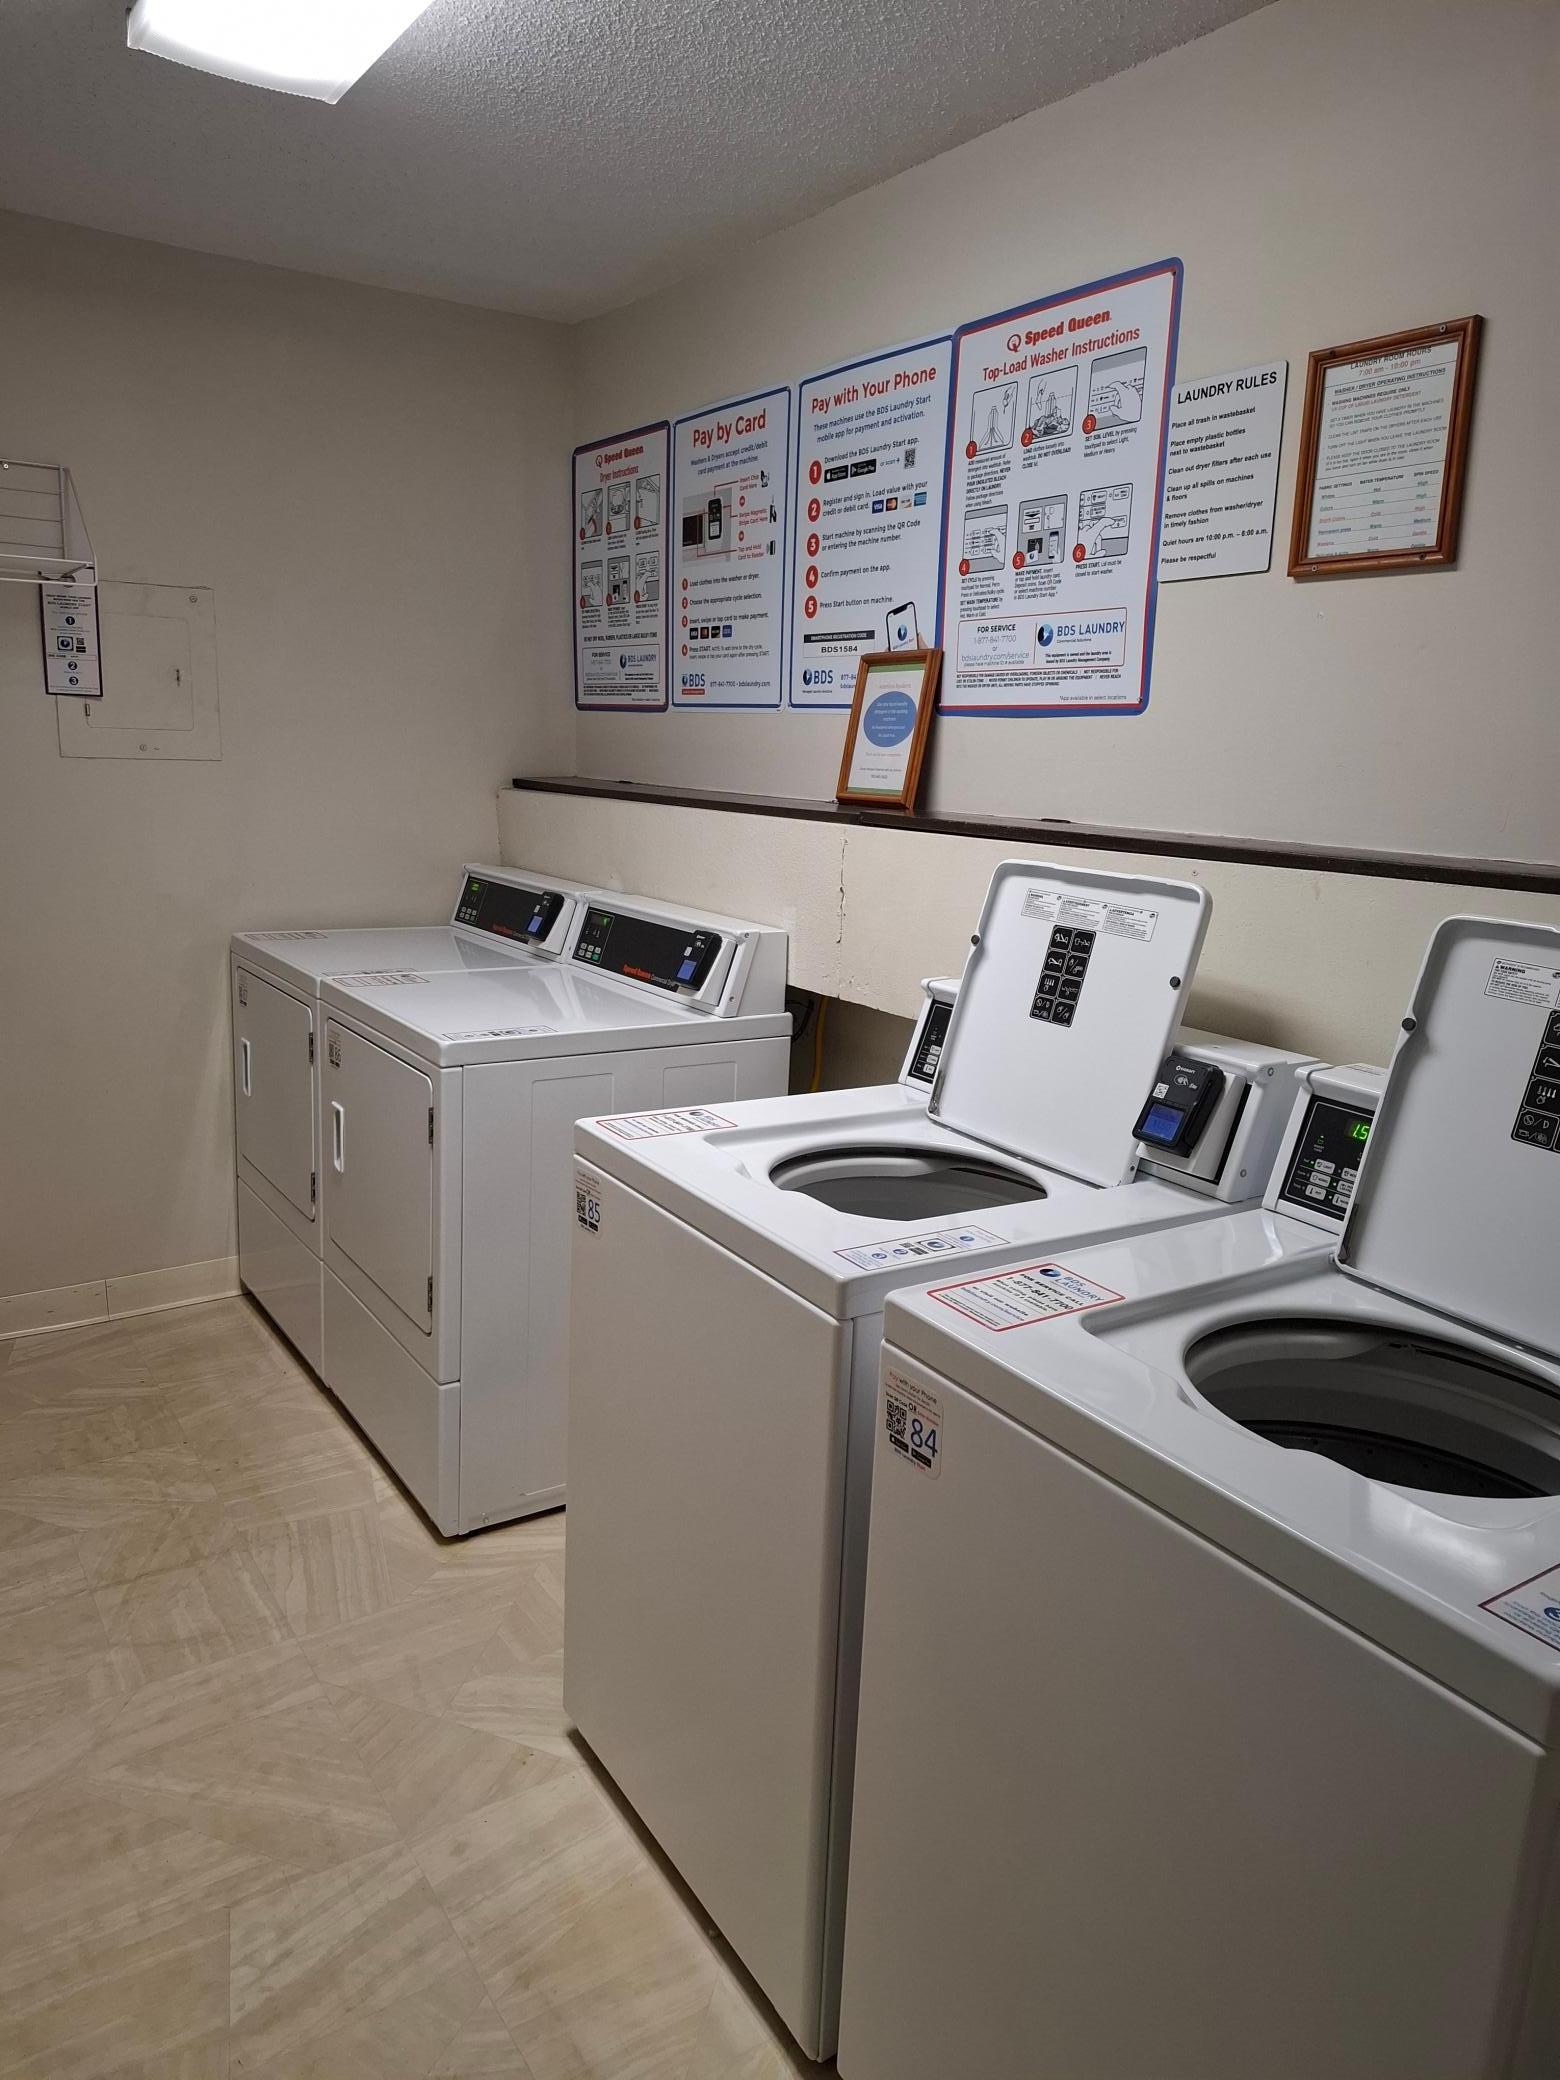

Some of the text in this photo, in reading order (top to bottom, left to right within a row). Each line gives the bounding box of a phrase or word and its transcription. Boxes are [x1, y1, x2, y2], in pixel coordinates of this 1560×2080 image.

[1025, 310, 1111, 346] Speed Queen
[983, 328, 1140, 381] Top-Load Washer Instructions
[812, 367, 936, 414] Pay with Your Phone
[1177, 372, 1277, 404] LAUNDRY RULES
[814, 423, 828, 432] These
[829, 416, 853, 428] machines
[866, 409, 875, 417] the
[877, 406, 888, 415] BDS
[890, 399, 914, 411] Laundry
[916, 395, 931, 404] Start
[1196, 416, 1210, 424] trash
[1219, 407, 1256, 419] wastebasket
[693, 408, 766, 448] Pay by Card
[817, 433, 834, 443] mobile
[835, 430, 844, 439] app
[855, 421, 879, 435] payment
[881, 418, 891, 426] and
[893, 410, 925, 423] activation.
[1187, 436, 1204, 444] empty
[1205, 432, 1224, 442] plastic
[1226, 428, 1246, 437] bottles
[825, 452, 848, 463] Download
[859, 447, 869, 456] BDS
[870, 443, 891, 453] Laundry
[893, 439, 905, 447] Start
[1190, 441, 1225, 453] wastebasket
[604, 446, 643, 465] Speed Queen
[1196, 463, 1211, 471] dryer
[1212, 459, 1228, 468] filters
[1230, 456, 1243, 464] after
[1200, 479, 1215, 488] spills
[1226, 474, 1254, 483] machines
[823, 497, 843, 506] Register
[854, 493, 864, 502] sign
[873, 488, 885, 496] Load
[902, 483, 914, 491] with
[915, 481, 928, 491] your
[823, 508, 836, 516] credit
[844, 505, 856, 513] debit
[1188, 508, 1208, 516] clothes
[1225, 500, 1263, 511] washer/dryer
[823, 532, 833, 540] Start
[835, 531, 855, 539] machine
[856, 529, 862, 537] by
[863, 525, 885, 535] scanning
[897, 521, 905, 530] QR
[1171, 520, 1186, 528] timely
[1188, 517, 1208, 525] fashion
[828, 542, 847, 550] entering
[858, 537, 879, 545] machine
[1206, 533, 1221, 541] 10:00
[1188, 552, 1216, 561] respectful
[821, 570, 839, 578] Confirm
[840, 568, 861, 577] payment
[991, 624, 1015, 632] SERVICE
[1057, 621, 1125, 636] BDS LAUNDRY
[689, 674, 705, 687] BDS
[813, 670, 833, 684] BDS
[588, 1199, 601, 1224] 85
[1055, 1278, 1104, 1301] LAUNDRY
[1063, 1276, 1085, 1287] BDS
[910, 1418, 938, 1459] 84
